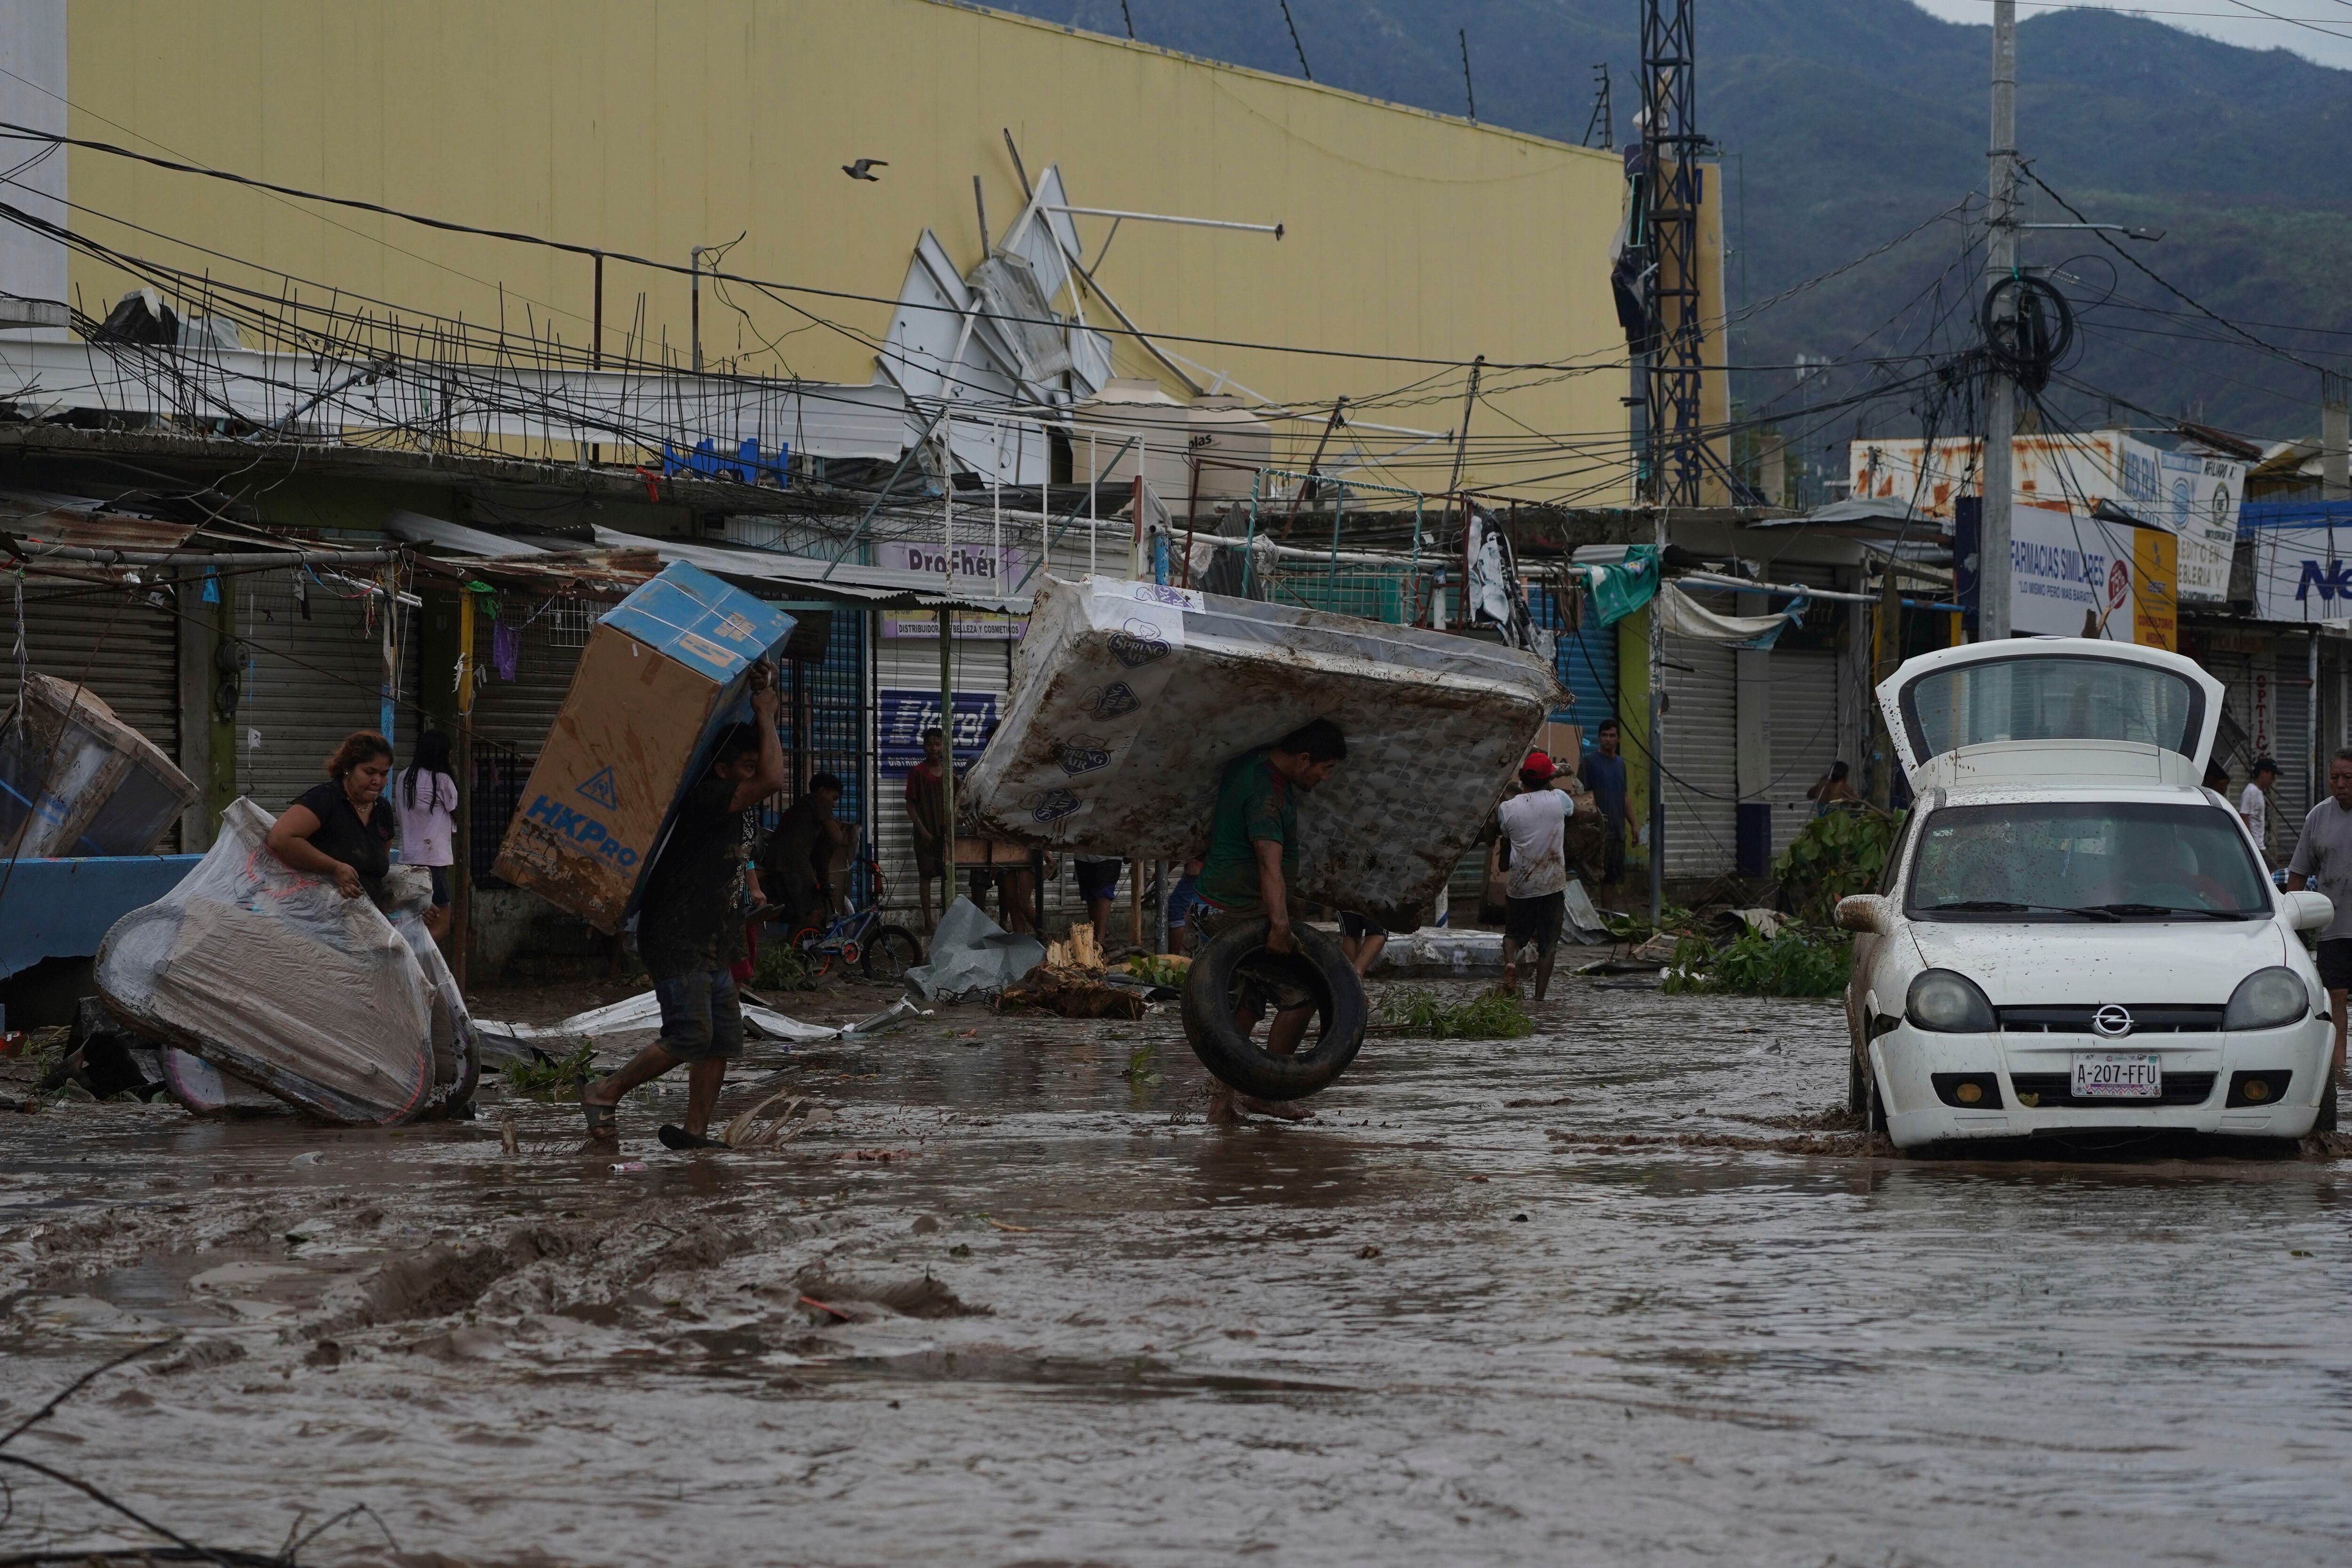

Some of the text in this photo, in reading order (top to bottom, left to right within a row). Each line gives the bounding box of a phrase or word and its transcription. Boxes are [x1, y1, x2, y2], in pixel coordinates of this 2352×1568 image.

[2010, 540, 2059, 579] FARMACIAS
[2061, 548, 2105, 587] SIMILARES
[2029, 582, 2045, 596] MISMO
[2047, 585, 2060, 598] PERO
[953, 625, 977, 634] BELLEZA
[984, 626, 1019, 634] COSMETICOS
[1113, 635, 1165, 657] SPRING
[1060, 748, 1104, 764] PRING
[1062, 756, 1088, 770] AIR
[2078, 1064, 2155, 1084] A-207-FFU
